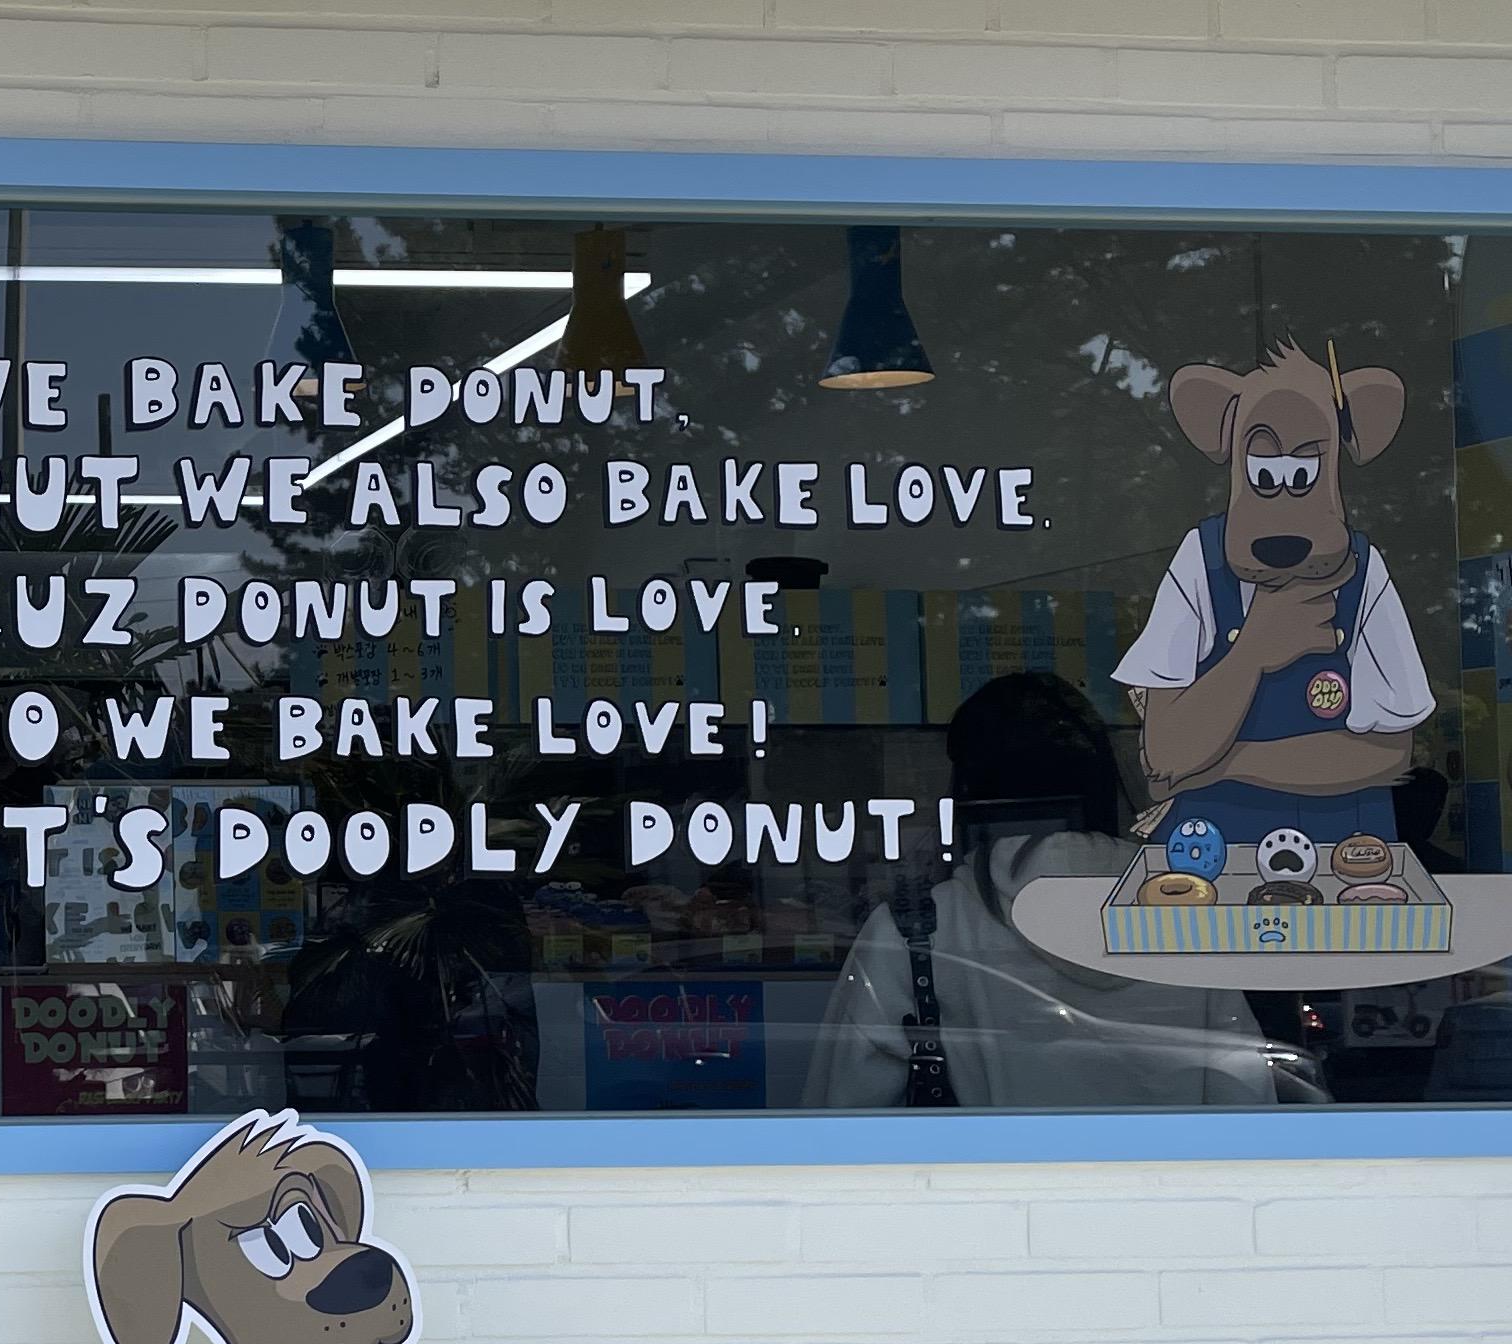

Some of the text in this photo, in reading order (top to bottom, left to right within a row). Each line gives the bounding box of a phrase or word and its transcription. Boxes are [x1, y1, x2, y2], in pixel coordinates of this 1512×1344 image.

[128, 356, 365, 428] BAKE
[406, 365, 692, 431] DONUT,
[177, 455, 313, 526] WE
[347, 460, 570, 528] ALSO
[604, 458, 821, 526] BAKE
[847, 462, 1054, 531] LOVE.
[181, 576, 458, 645] DONUT
[489, 577, 557, 637] IS
[588, 575, 802, 639] LOVE.
[103, 695, 232, 762] WE
[276, 695, 496, 762] BAKE
[535, 697, 769, 758] LOVE!
[216, 801, 583, 881] DOODLY
[627, 796, 958, 868] DONUT!
[12, 994, 177, 1030] DOODLY
[594, 994, 755, 1026] DOODLY
[21, 1029, 169, 1064] DONUT
[602, 1026, 751, 1062] DONUT
